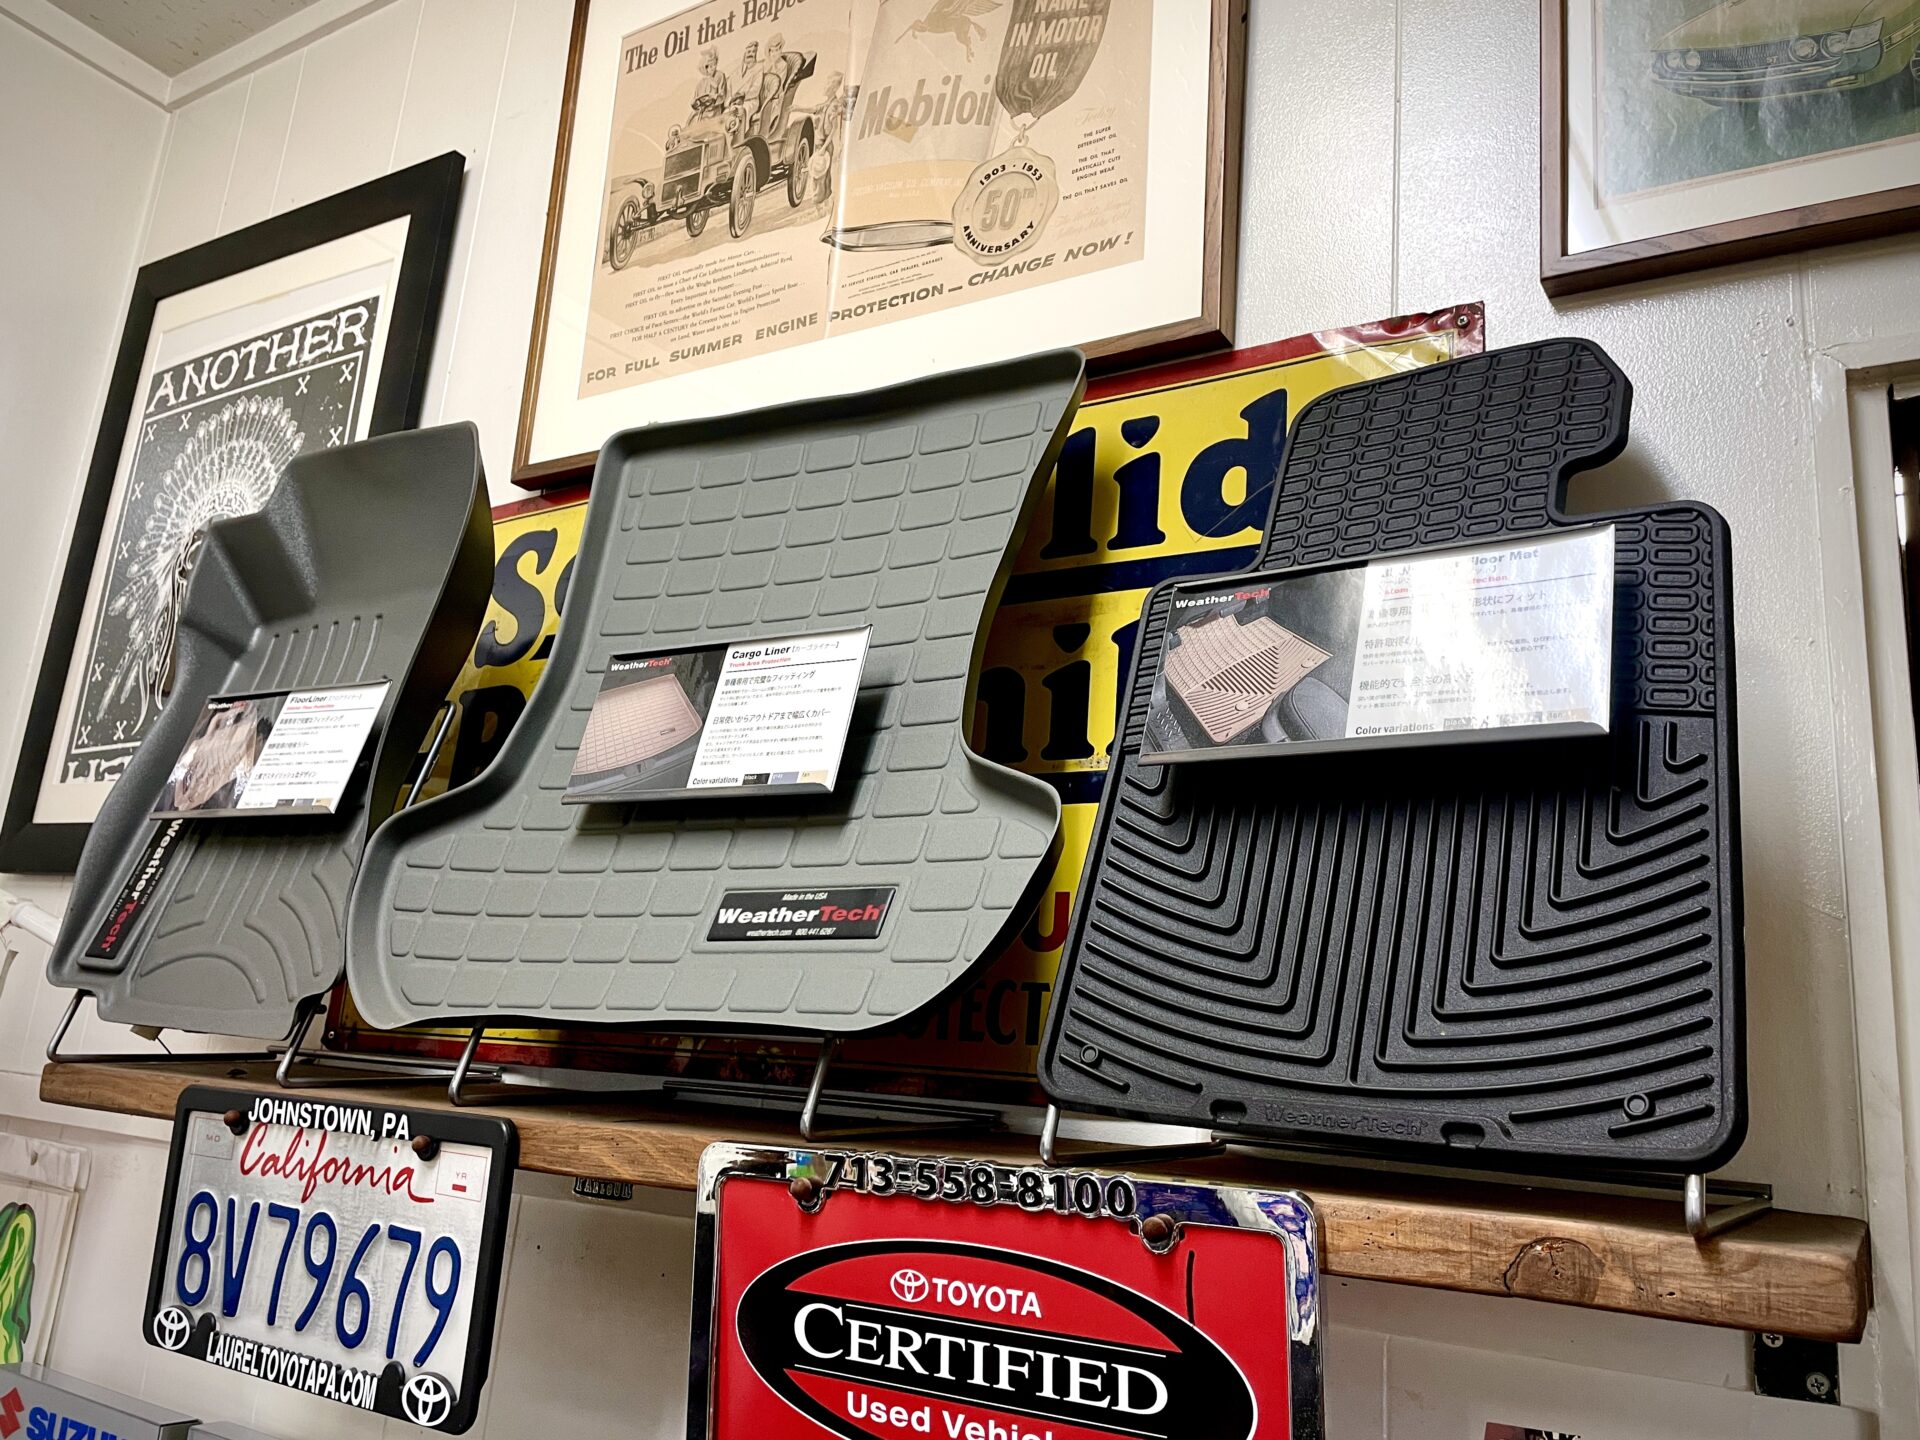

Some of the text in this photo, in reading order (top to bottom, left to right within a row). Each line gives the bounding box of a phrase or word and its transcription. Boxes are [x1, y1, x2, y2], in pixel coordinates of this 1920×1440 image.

[625, 0, 806, 75] The Oil that Helpe
[1009, 14, 1103, 48] IN MOTOR
[1029, 51, 1059, 79] OIL
[1101, 148, 1115, 157] THAT
[979, 163, 1007, 187] 1903
[1021, 161, 1043, 182] 1953
[1084, 186, 1099, 195] THAT
[1099, 181, 1117, 190] SAVES
[962, 219, 1035, 254] ANNIVERSARY
[586, 366, 617, 384] FOR
[624, 356, 660, 375] FULL
[668, 334, 743, 363] SUMMER
[755, 312, 819, 341] ENGINE
[828, 283, 945, 323] PROTECTION
[967, 253, 1056, 287] CHANGE
[144, 303, 370, 414] ANOTHER
[1509, 548, 1540, 562] Mat
[1175, 587, 1272, 609] WeatherTech
[610, 656, 672, 672] WeatherTech
[732, 648, 762, 661] Cargo
[764, 645, 791, 657] Liner
[1355, 719, 1435, 735] Color variations
[101, 819, 184, 949] WeatherTech
[717, 904, 884, 924] WeatherTech
[248, 1097, 411, 1141] JOHNSTOWN, PA
[1265, 1103, 1424, 1136] WeatherTech
[239, 1122, 435, 1204] California
[823, 1153, 1135, 1219] 713-558-8100
[176, 1191, 462, 1368] 8V79679
[932, 1277, 1042, 1319] TOYOTA
[205, 1331, 378, 1411] LAURELTOYOTAPA.COM
[793, 1302, 1169, 1417] CERTIFIED
[846, 1390, 931, 1433] Used
